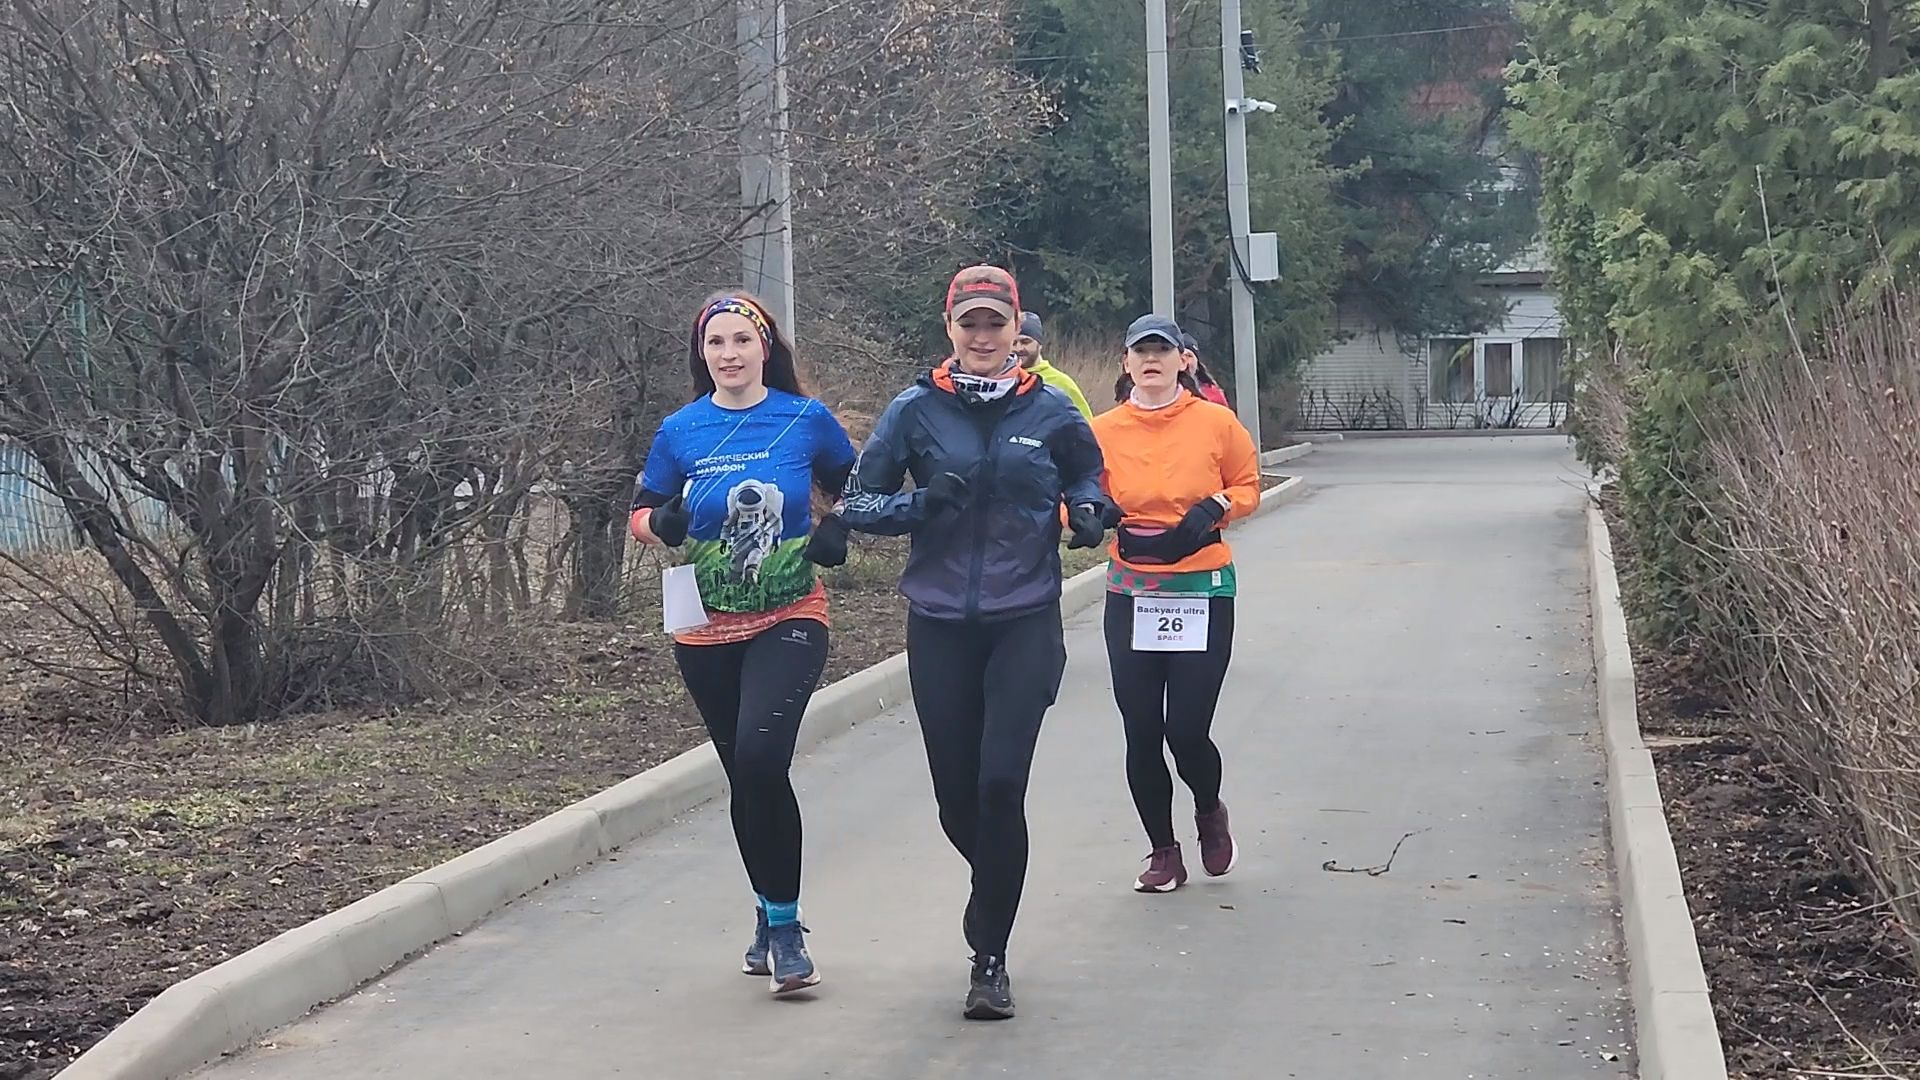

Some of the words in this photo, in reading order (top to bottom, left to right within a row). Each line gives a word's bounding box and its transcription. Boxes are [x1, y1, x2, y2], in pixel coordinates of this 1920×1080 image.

[695, 451, 769, 467] КОСМИЧЕСКИЙ
[696, 464, 746, 475] МАРАФОН
[1137, 606, 1181, 615] Backyard
[1183, 607, 1205, 615] ultra
[1158, 617, 1183, 632] 26
